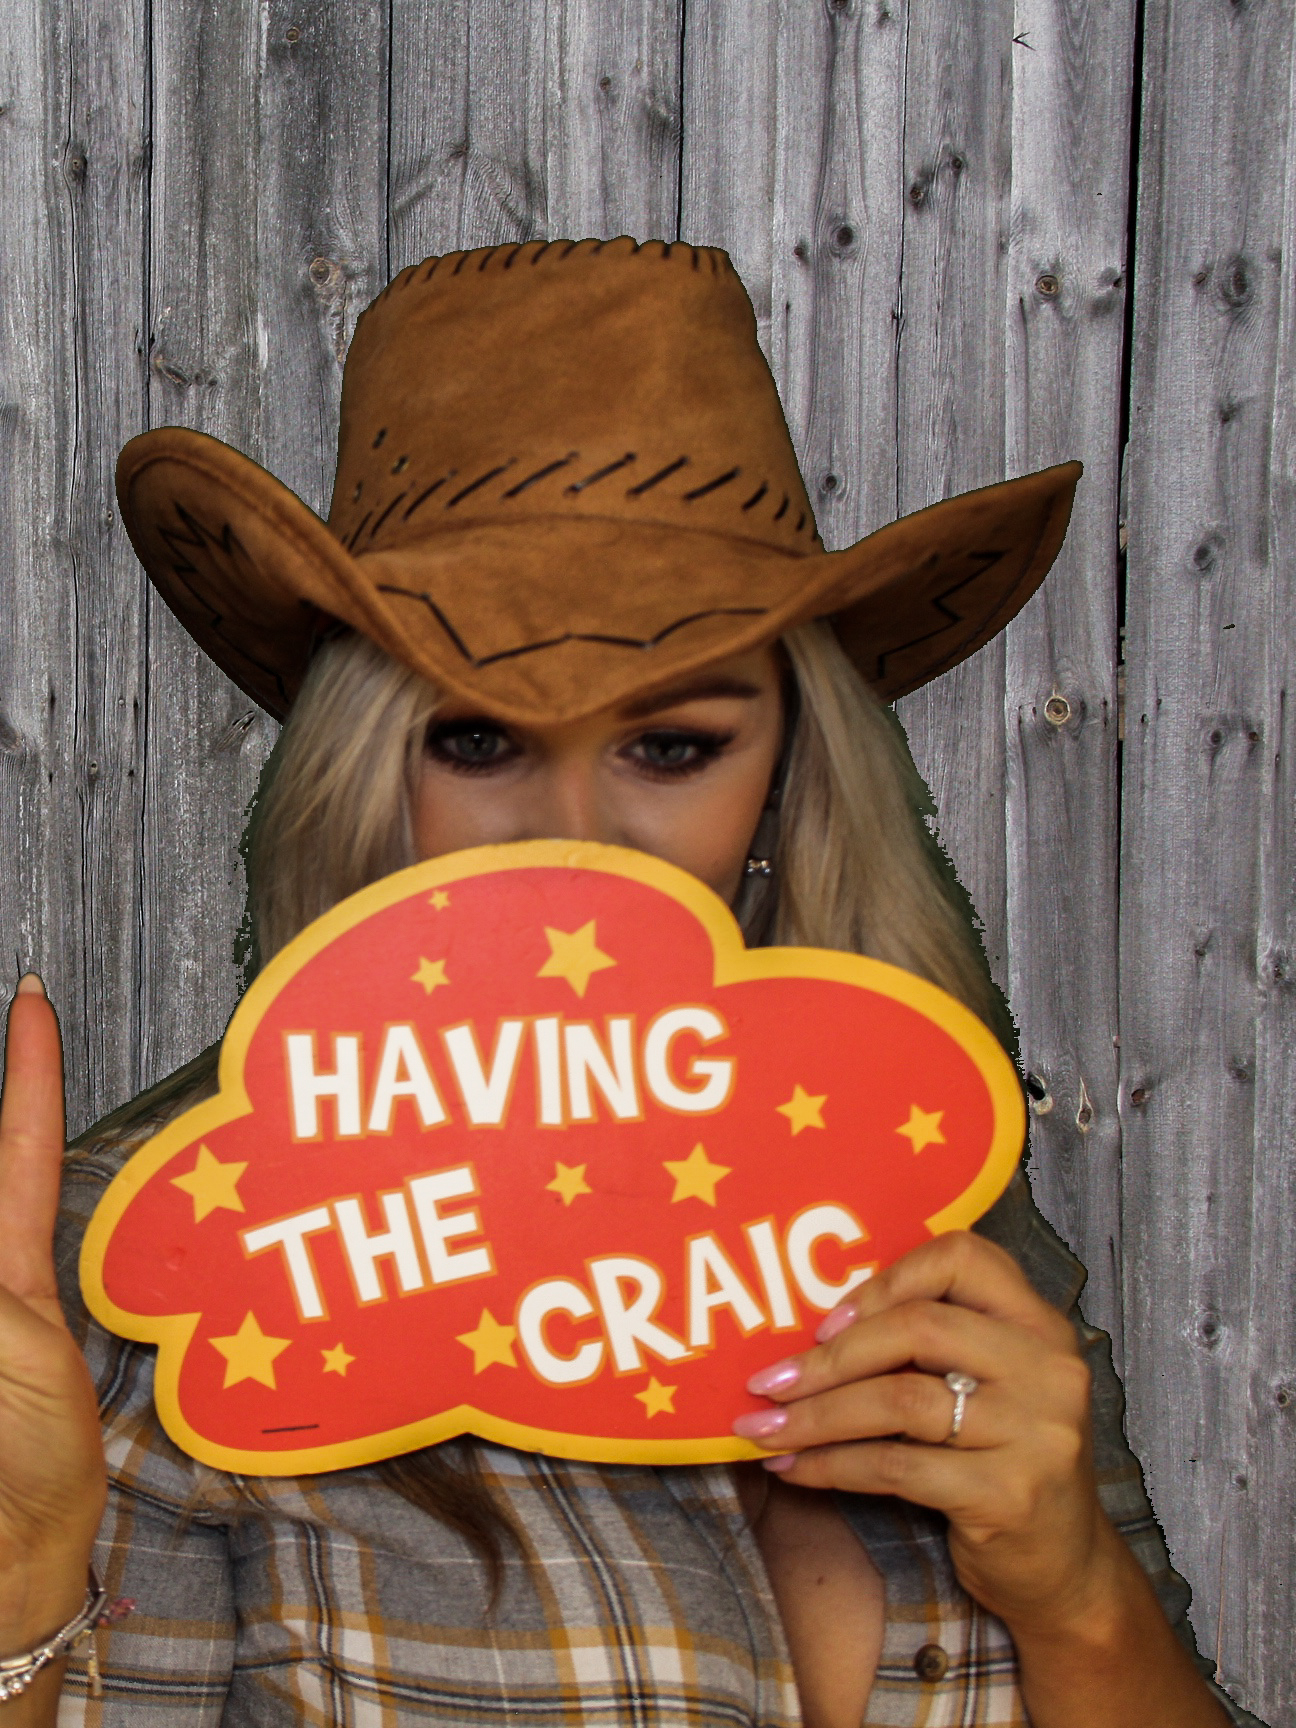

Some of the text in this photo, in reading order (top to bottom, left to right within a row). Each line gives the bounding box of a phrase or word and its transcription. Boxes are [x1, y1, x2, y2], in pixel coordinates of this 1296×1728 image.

[286, 1007, 734, 1137] HAVING
[244, 1167, 492, 1318] THE
[518, 1204, 875, 1383] CRAIC
